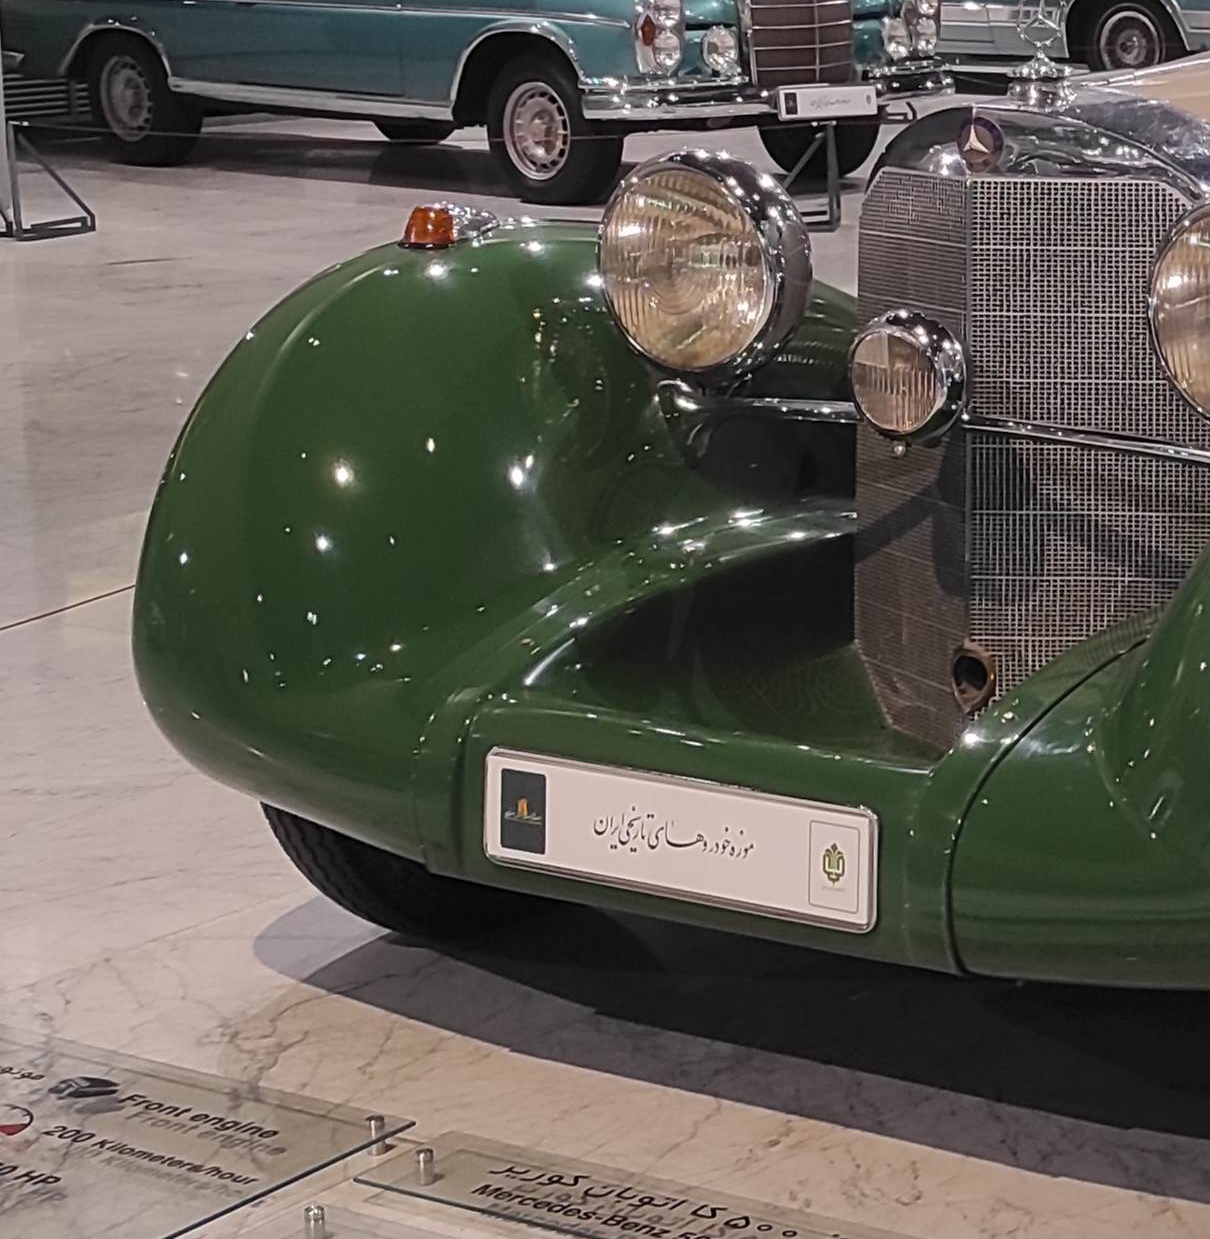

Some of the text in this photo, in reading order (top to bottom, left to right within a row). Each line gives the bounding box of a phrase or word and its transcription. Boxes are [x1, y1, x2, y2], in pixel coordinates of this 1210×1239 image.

[593, 805, 755, 859] موزه خودروهای تاریخی ایران
[117, 1093, 281, 1140] Front engine
[41, 1125, 96, 1144] 200
[12, 1170, 62, 1186] HP
[488, 1165, 591, 1187] کوریر
[471, 1184, 671, 1239] Mercedes-Benz
[583, 1185, 689, 1212] اتوبان
